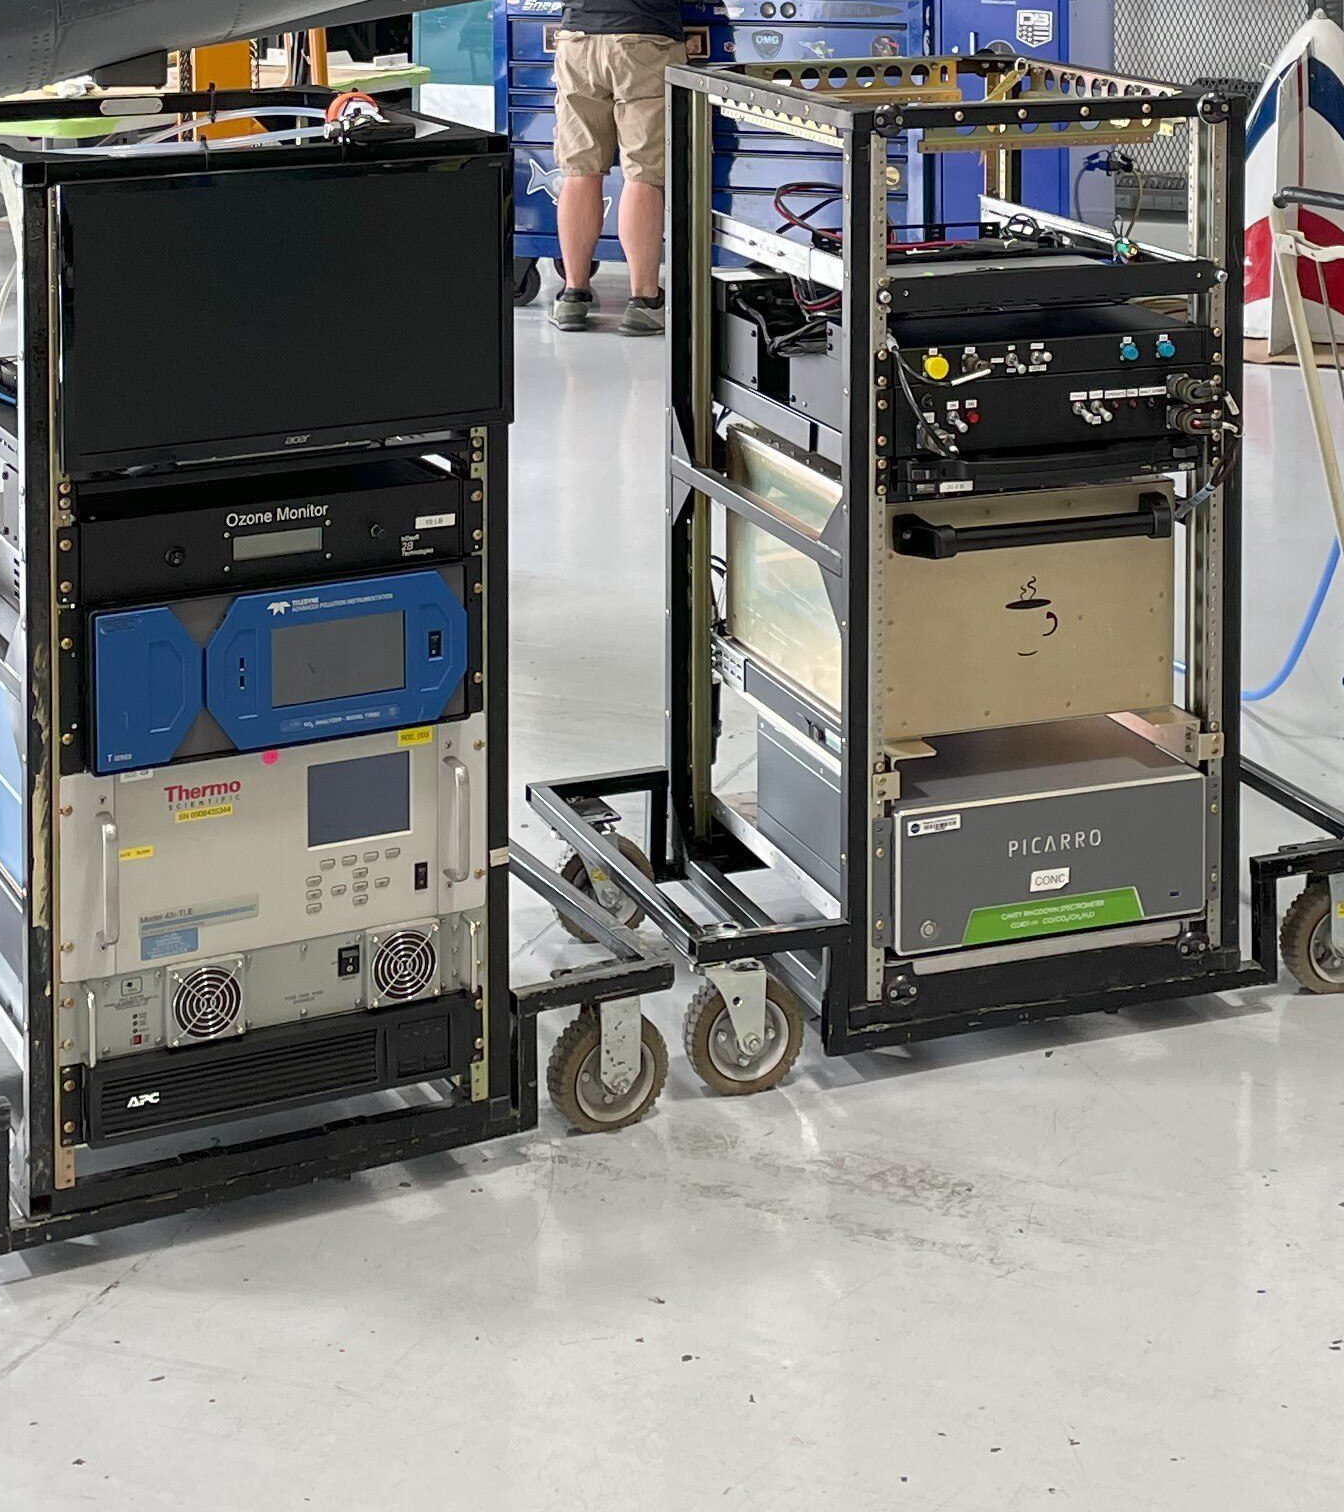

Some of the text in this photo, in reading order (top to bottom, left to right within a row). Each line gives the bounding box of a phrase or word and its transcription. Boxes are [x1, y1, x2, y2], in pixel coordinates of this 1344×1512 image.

[755, 34, 780, 45] OMG
[285, 434, 311, 445] acer
[226, 504, 329, 527] Ozone Monitor
[164, 780, 242, 803] Thermo
[168, 795, 241, 811] SCIENTIFIC
[1008, 829, 1102, 858] PICARRO
[1035, 873, 1066, 887] CONC
[140, 913, 163, 924] Model
[127, 1092, 160, 1108] APC
